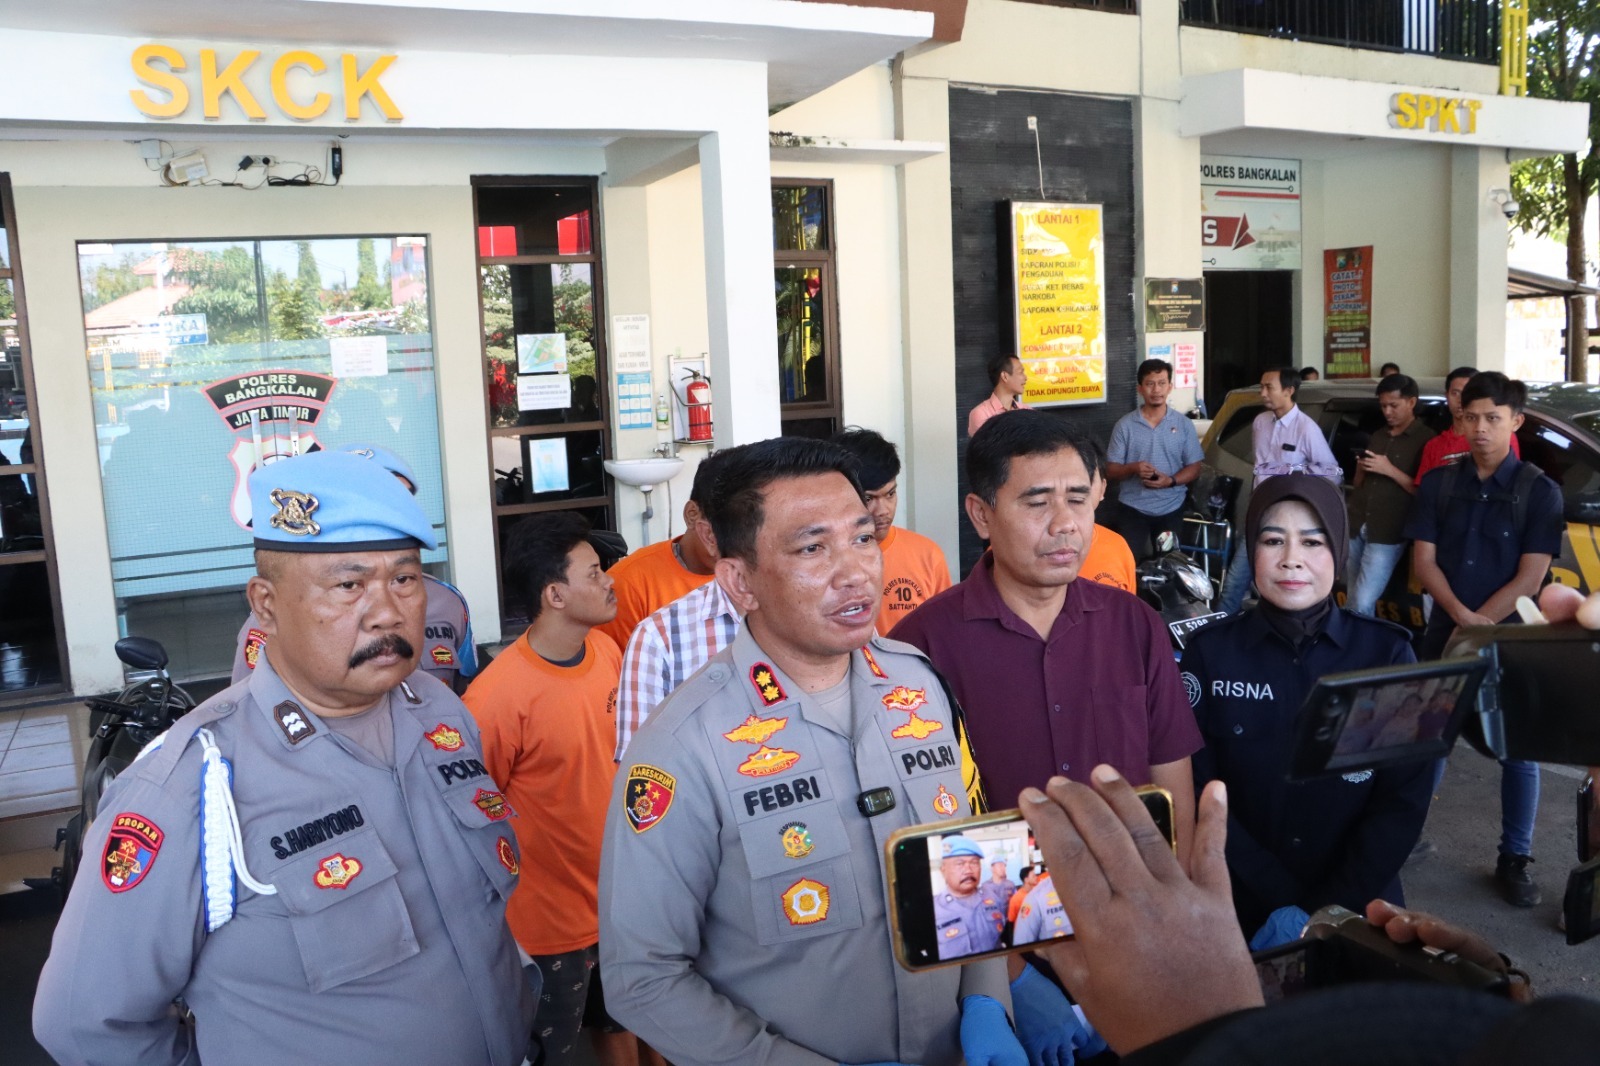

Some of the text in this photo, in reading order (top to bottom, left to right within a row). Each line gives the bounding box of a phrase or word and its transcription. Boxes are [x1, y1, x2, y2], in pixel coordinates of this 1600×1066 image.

[129, 44, 404, 122] SKCK
[1387, 92, 1482, 134] SPKT
[1238, 167, 1297, 182] BANGKALAN
[1037, 214, 1080, 224] LANTAI 1
[1021, 293, 1057, 301] NARKOBA
[1022, 306, 1055, 314] LAPORAN
[1040, 324, 1083, 335] LANTAI 2
[239, 375, 297, 389] POLRES
[1047, 387, 1080, 395] DIPUNGUT
[1081, 385, 1100, 393] BIAYA
[225, 385, 317, 404] BANGKALAN
[895, 587, 912, 601] 10
[425, 626, 454, 639] OLRI
[1212, 680, 1274, 701] RISNA
[901, 745, 956, 775] POLRI
[632, 767, 673, 788] BARESKRIM
[743, 776, 821, 817] FEBRI
[118, 817, 158, 841] PROPAM
[270, 804, 365, 860] S.HARIYONO
